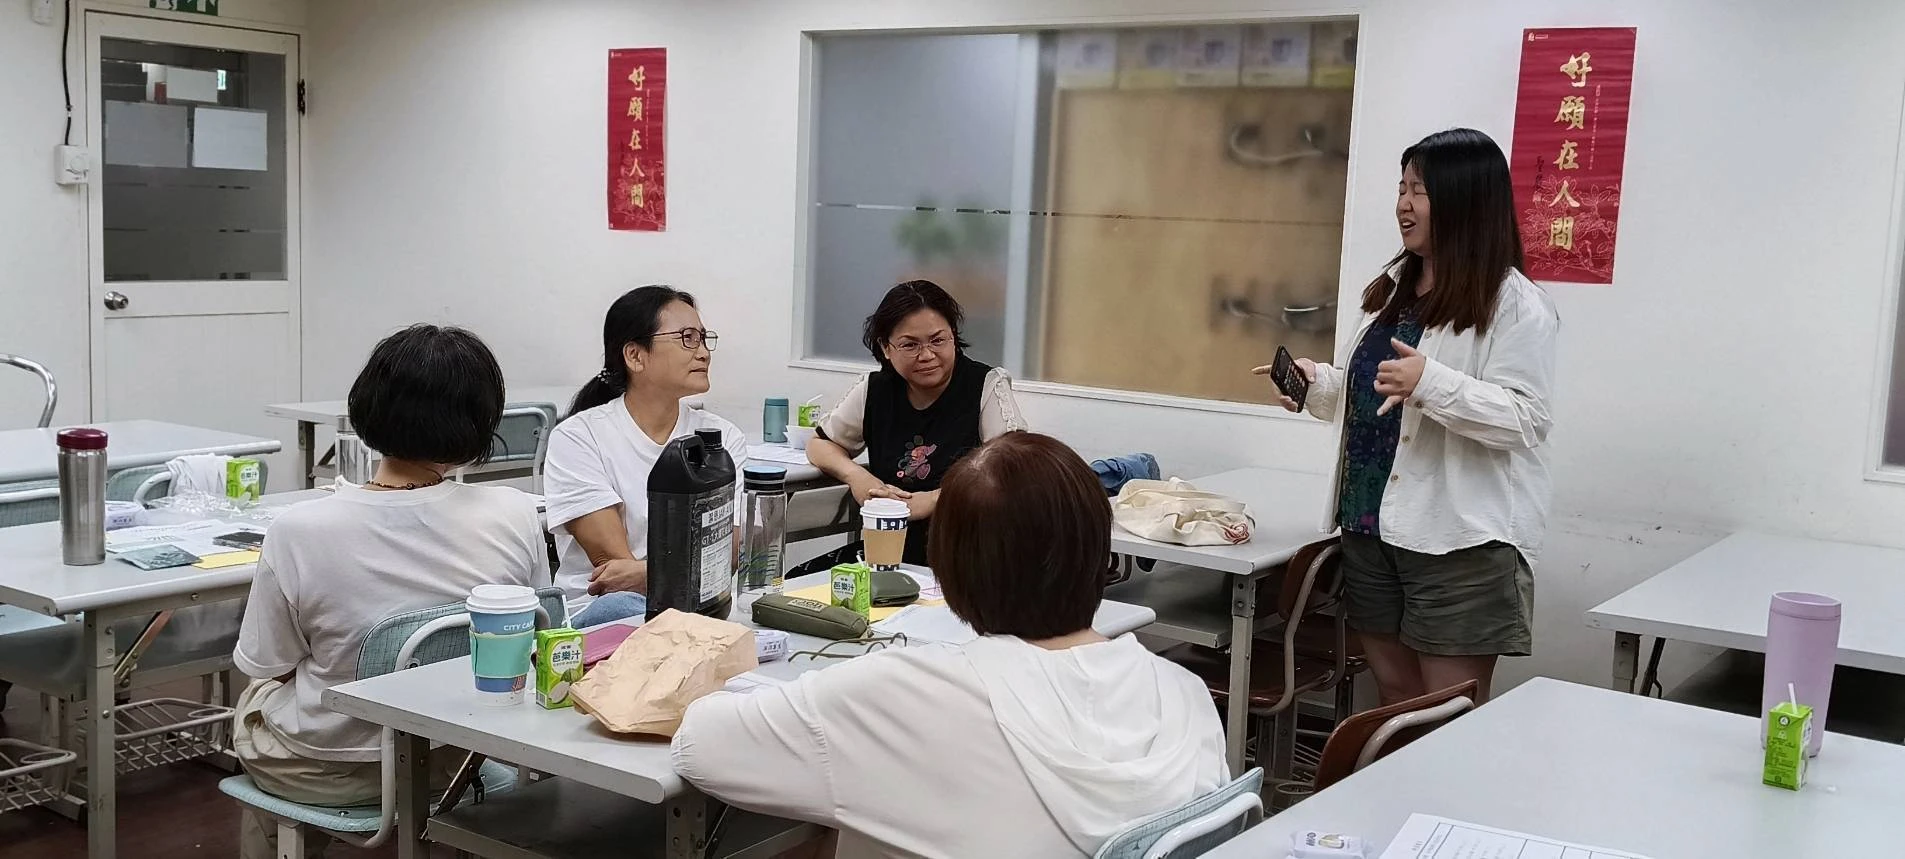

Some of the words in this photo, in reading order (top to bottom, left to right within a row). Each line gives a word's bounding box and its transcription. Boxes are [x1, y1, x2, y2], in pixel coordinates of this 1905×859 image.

[627, 65, 646, 209] 好願在人間
[1549, 51, 1593, 251] 好願在人間
[552, 650, 582, 663] 芭樂汁
